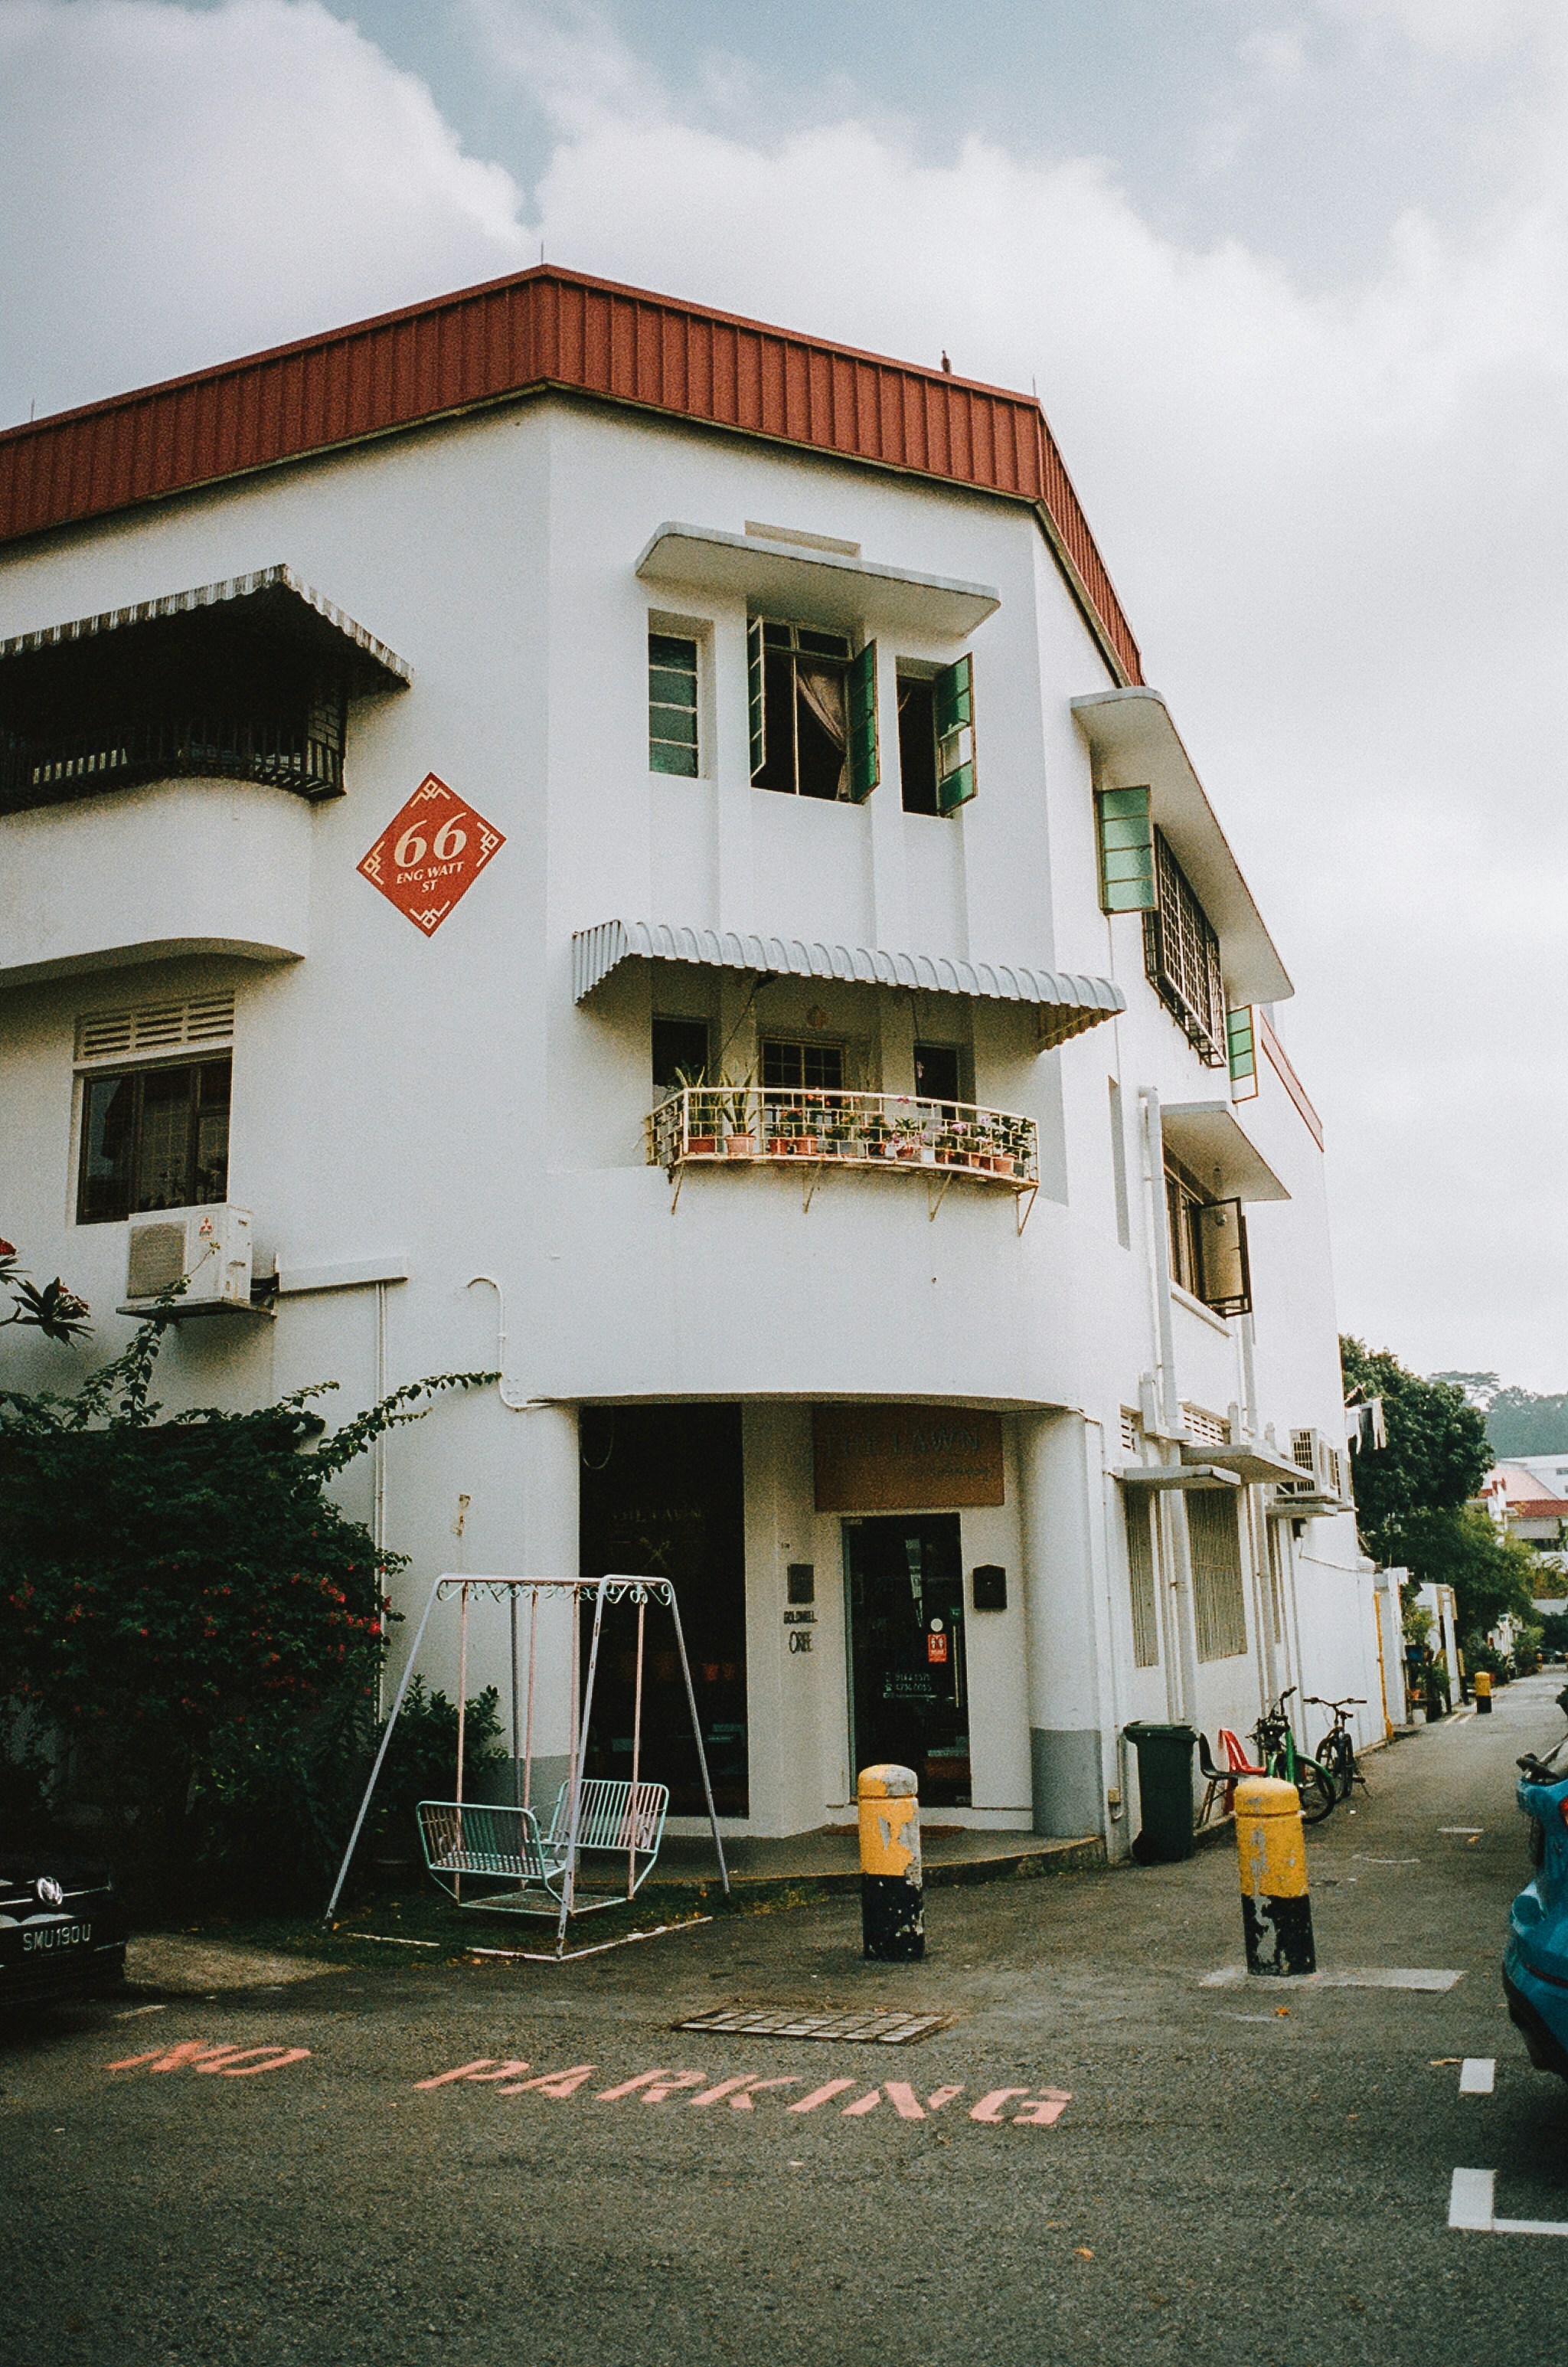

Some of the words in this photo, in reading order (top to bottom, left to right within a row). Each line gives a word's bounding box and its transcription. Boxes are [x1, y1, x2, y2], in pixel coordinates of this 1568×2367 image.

[394, 812, 467, 868] 66
[396, 869, 424, 884] ENG
[427, 861, 465, 878] WATT
[421, 880, 437, 894] ST
[104, 2040, 311, 2076] NO
[413, 2058, 1073, 2126] PARKING
